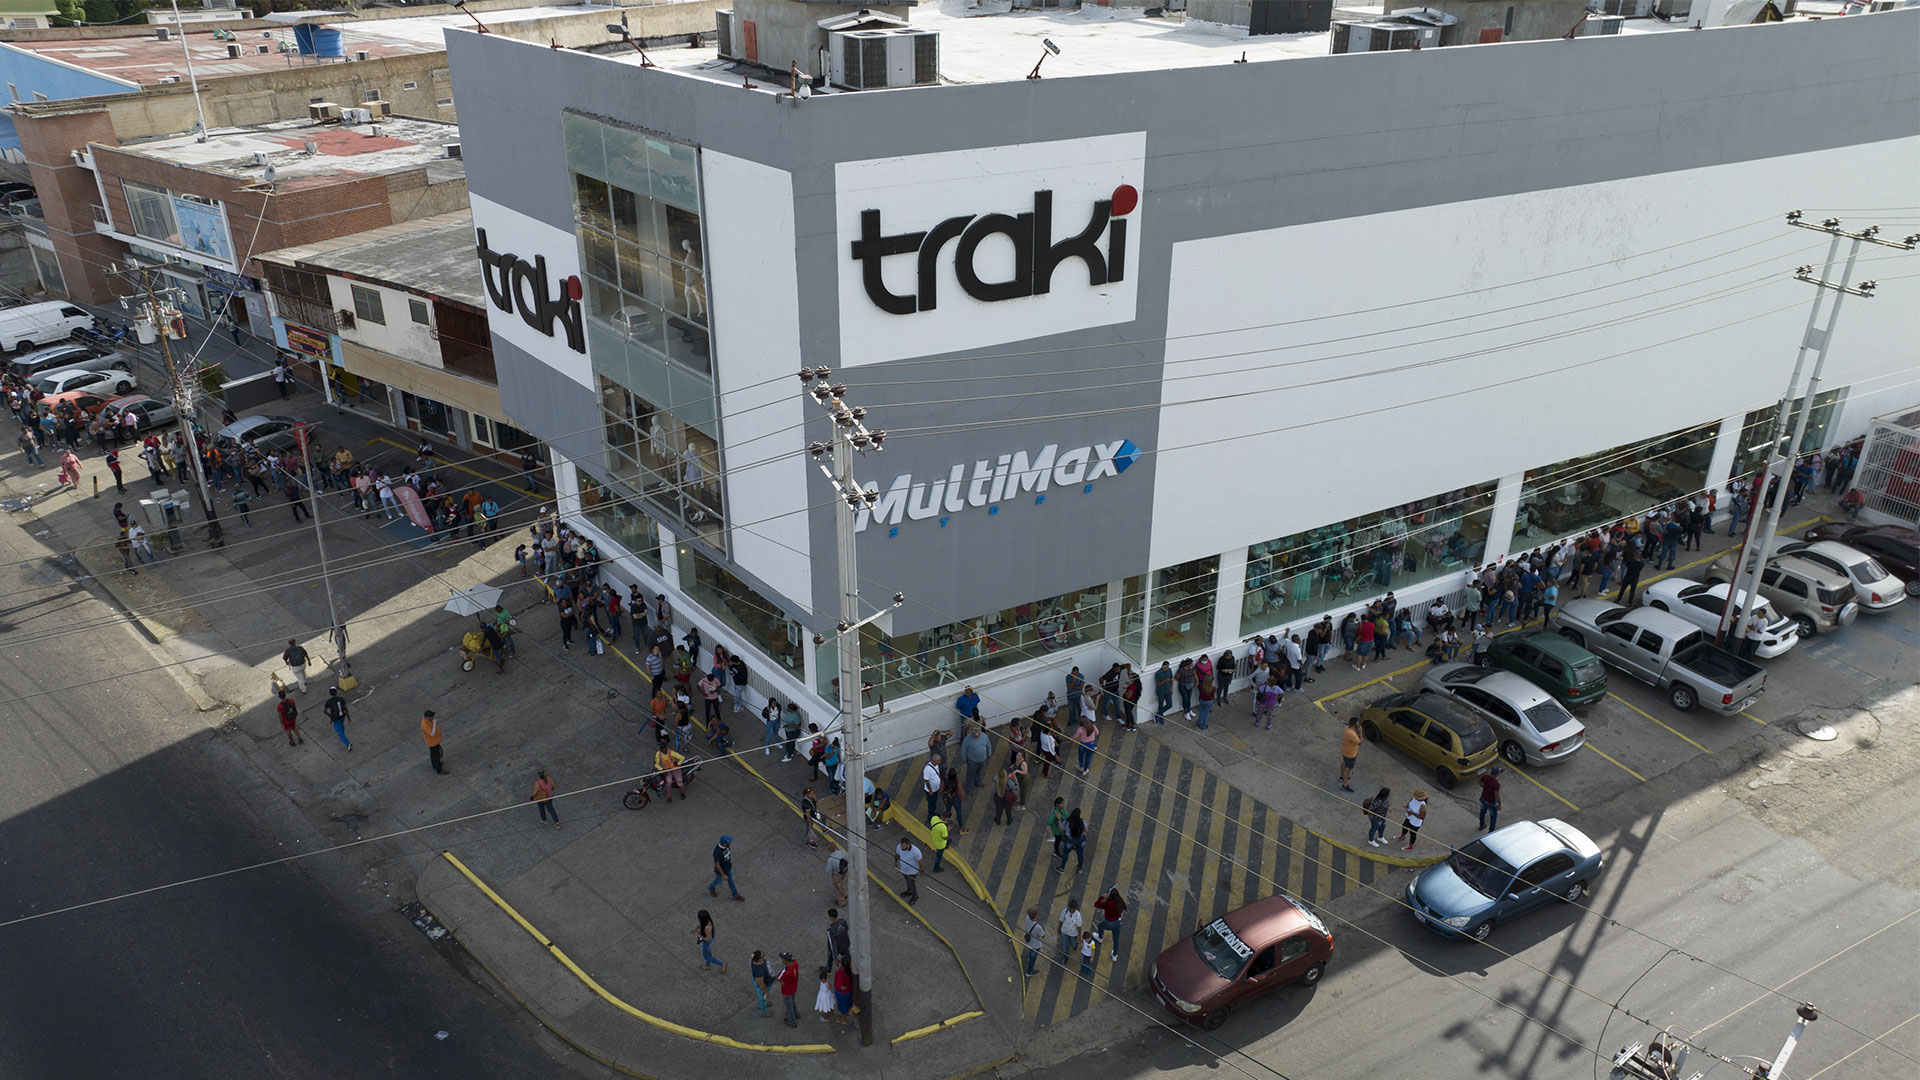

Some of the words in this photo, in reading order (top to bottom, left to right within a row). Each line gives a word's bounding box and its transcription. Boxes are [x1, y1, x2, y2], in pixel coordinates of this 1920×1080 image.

[476, 227, 586, 354] traki
[851, 184, 1138, 315] traki
[855, 439, 1125, 533] MultiMax
[889, 483, 1093, 538] STORE
